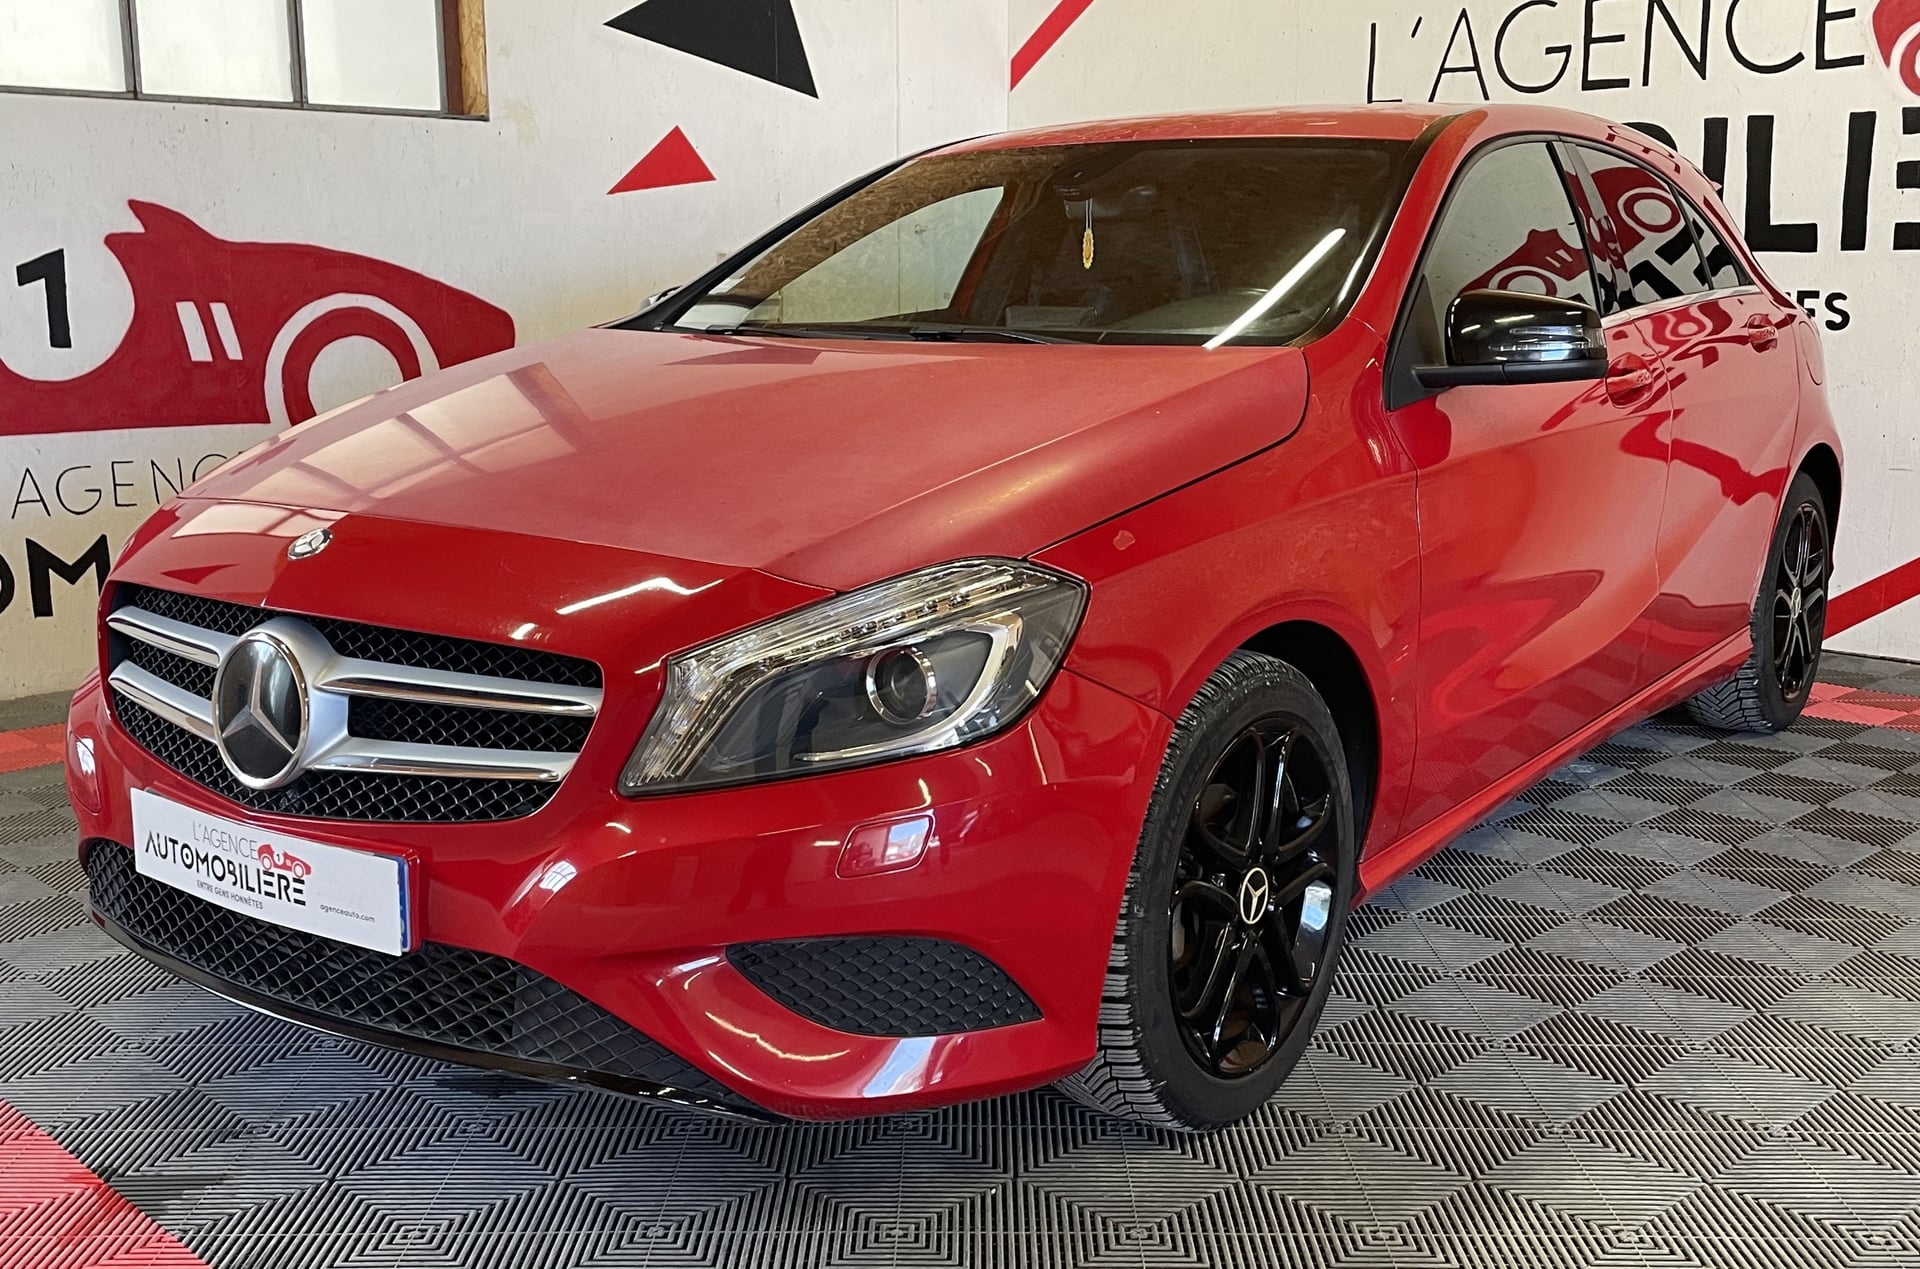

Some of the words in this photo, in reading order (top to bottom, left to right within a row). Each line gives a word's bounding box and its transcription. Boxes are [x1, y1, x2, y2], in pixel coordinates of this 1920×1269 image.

[1367, 0, 1866, 104] L'AGENCE
[16, 248, 72, 349] 1
[192, 820, 259, 861] L'AGENCE
[196, 879, 214, 894] ENTRE
[214, 886, 230, 899] GENS
